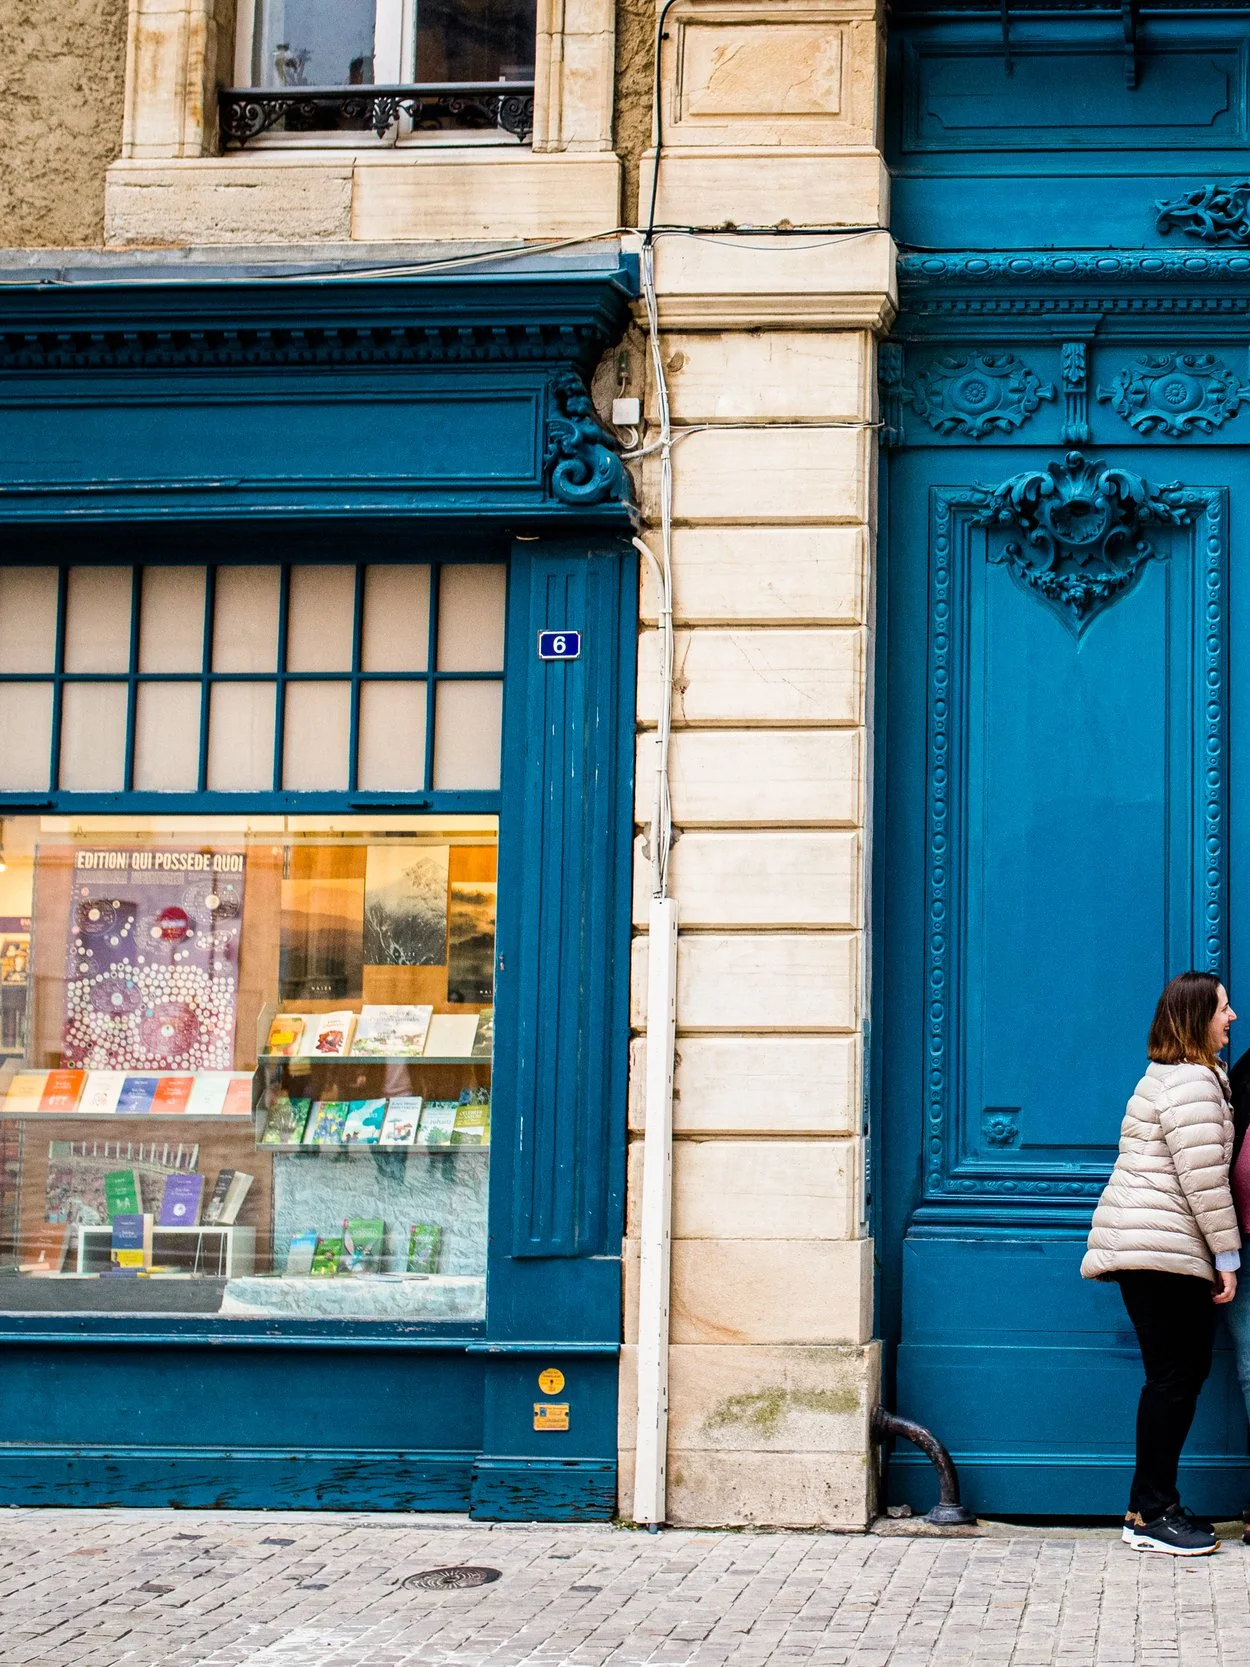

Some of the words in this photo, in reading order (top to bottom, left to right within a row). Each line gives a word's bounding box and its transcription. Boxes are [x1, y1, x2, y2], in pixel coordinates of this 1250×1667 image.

[553, 636, 566, 653] 6
[131, 852, 151, 871] QUI
[213, 854, 244, 872] QUOI
